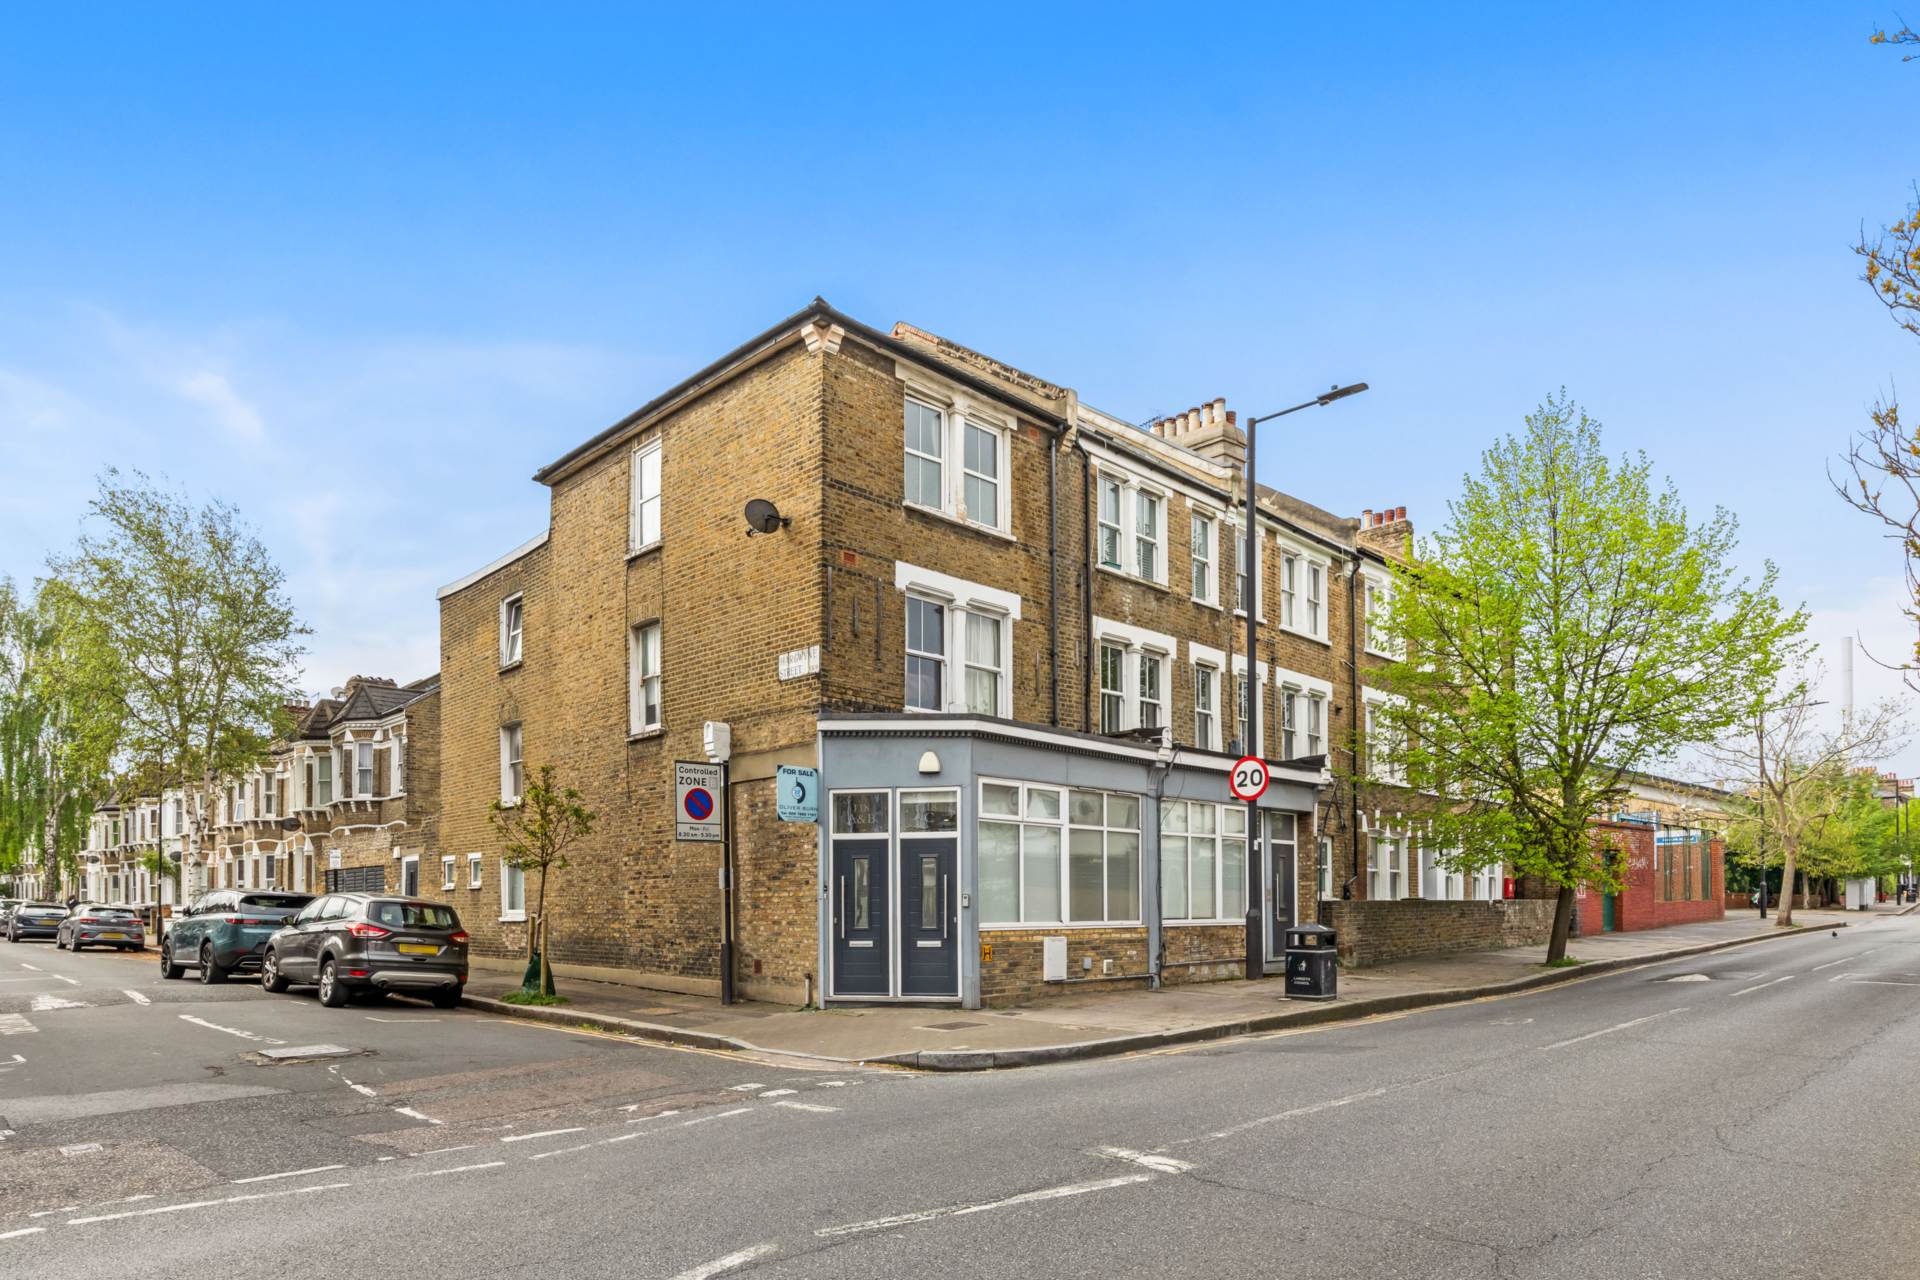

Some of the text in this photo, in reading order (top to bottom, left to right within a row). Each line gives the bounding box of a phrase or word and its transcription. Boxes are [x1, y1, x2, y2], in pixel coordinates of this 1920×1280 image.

[780, 665, 802, 679] STREET
[679, 766, 718, 779] Controlled
[1237, 769, 1263, 787] 20
[679, 776, 707, 787] ZONE
